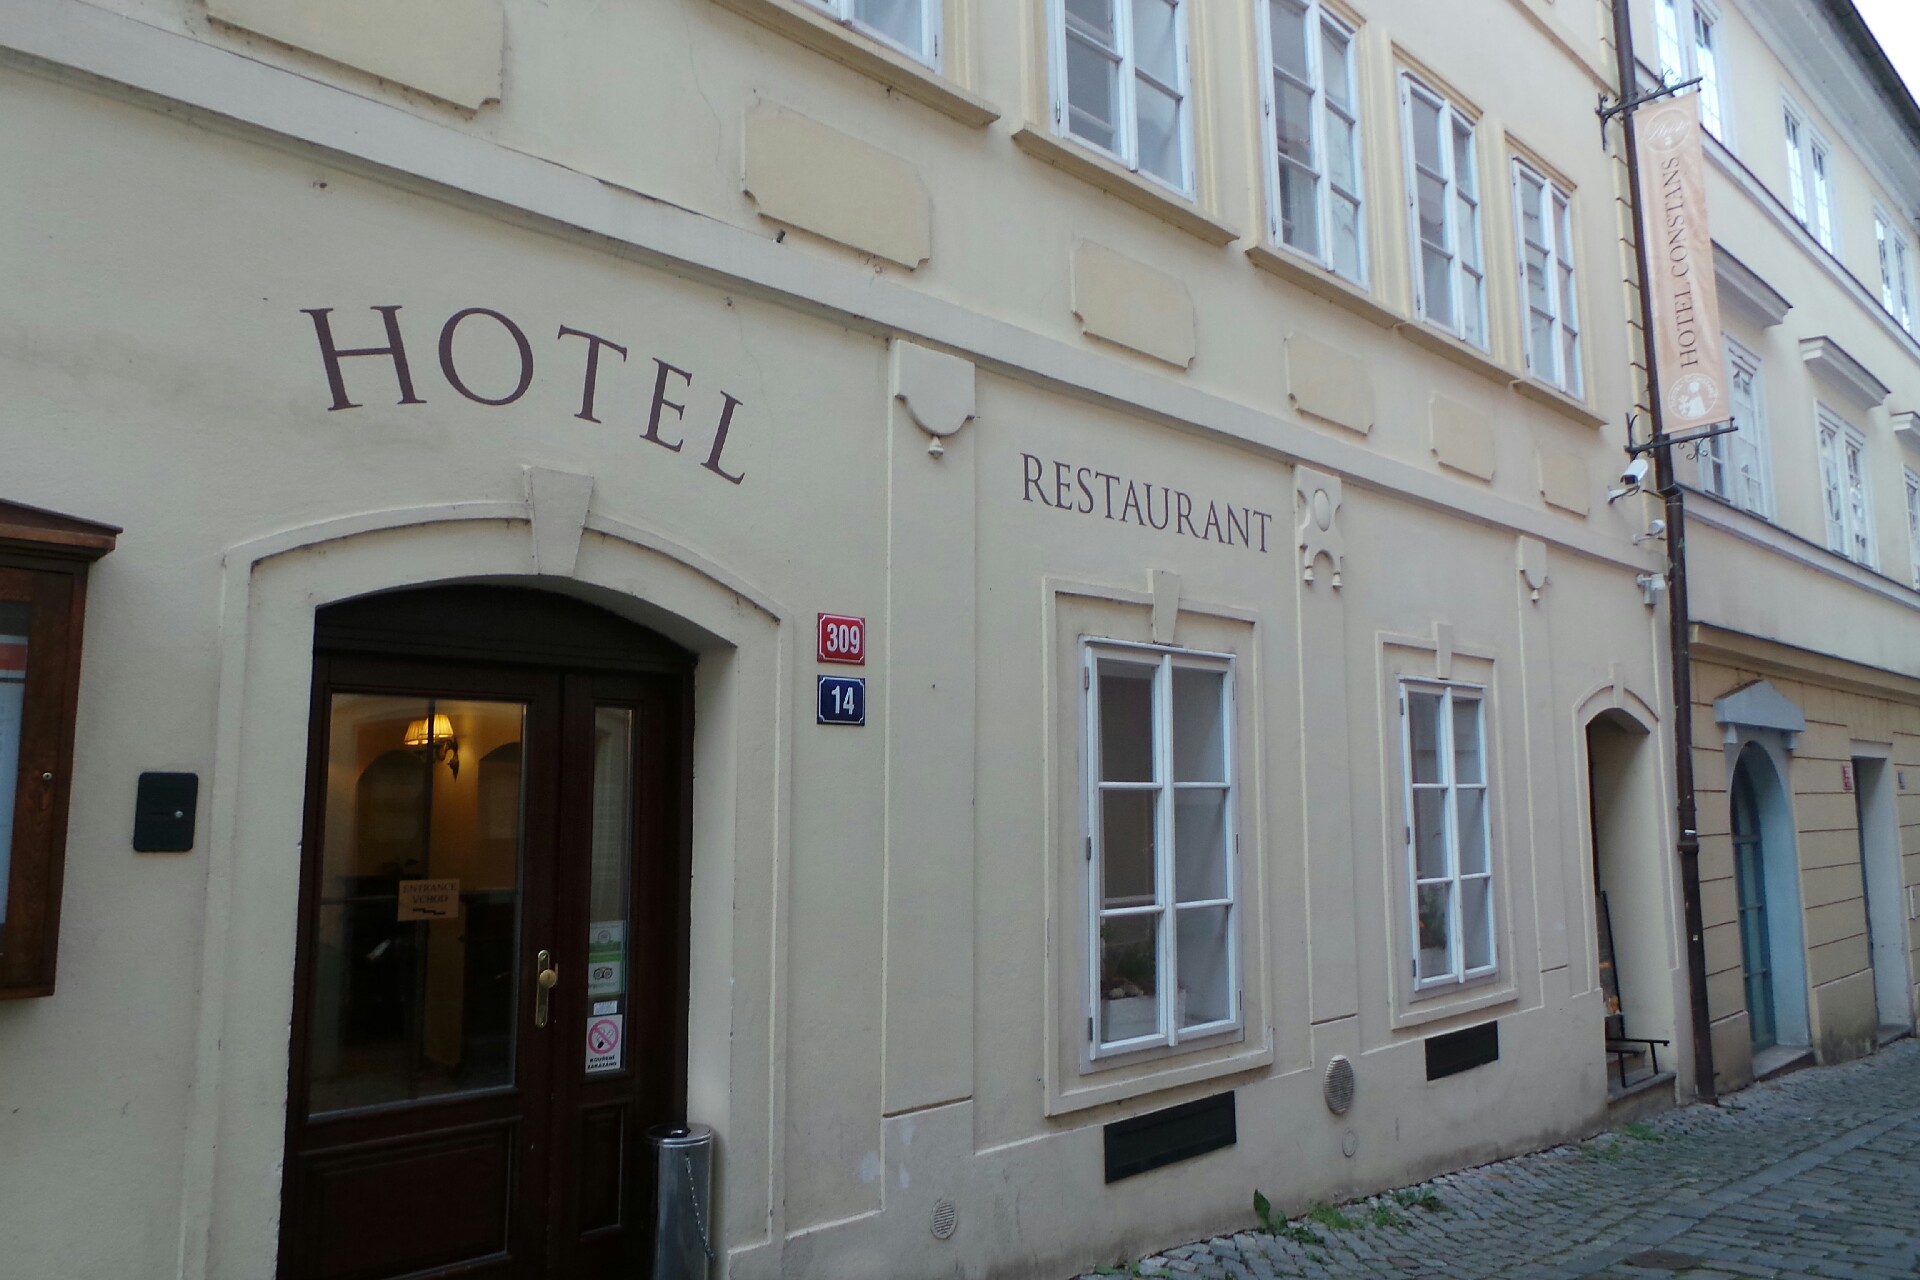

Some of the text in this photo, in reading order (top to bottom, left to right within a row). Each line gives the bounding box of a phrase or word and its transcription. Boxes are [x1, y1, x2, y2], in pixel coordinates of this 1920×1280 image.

[1661, 156, 1690, 277] CONSTANS
[1674, 281, 1698, 369] HOTEL
[300, 305, 746, 485] HOTEL
[1020, 452, 1272, 553] RESTAURANT
[826, 622, 860, 655] 309
[831, 685, 855, 715] 14
[403, 882, 456, 893] ENTRANCE
